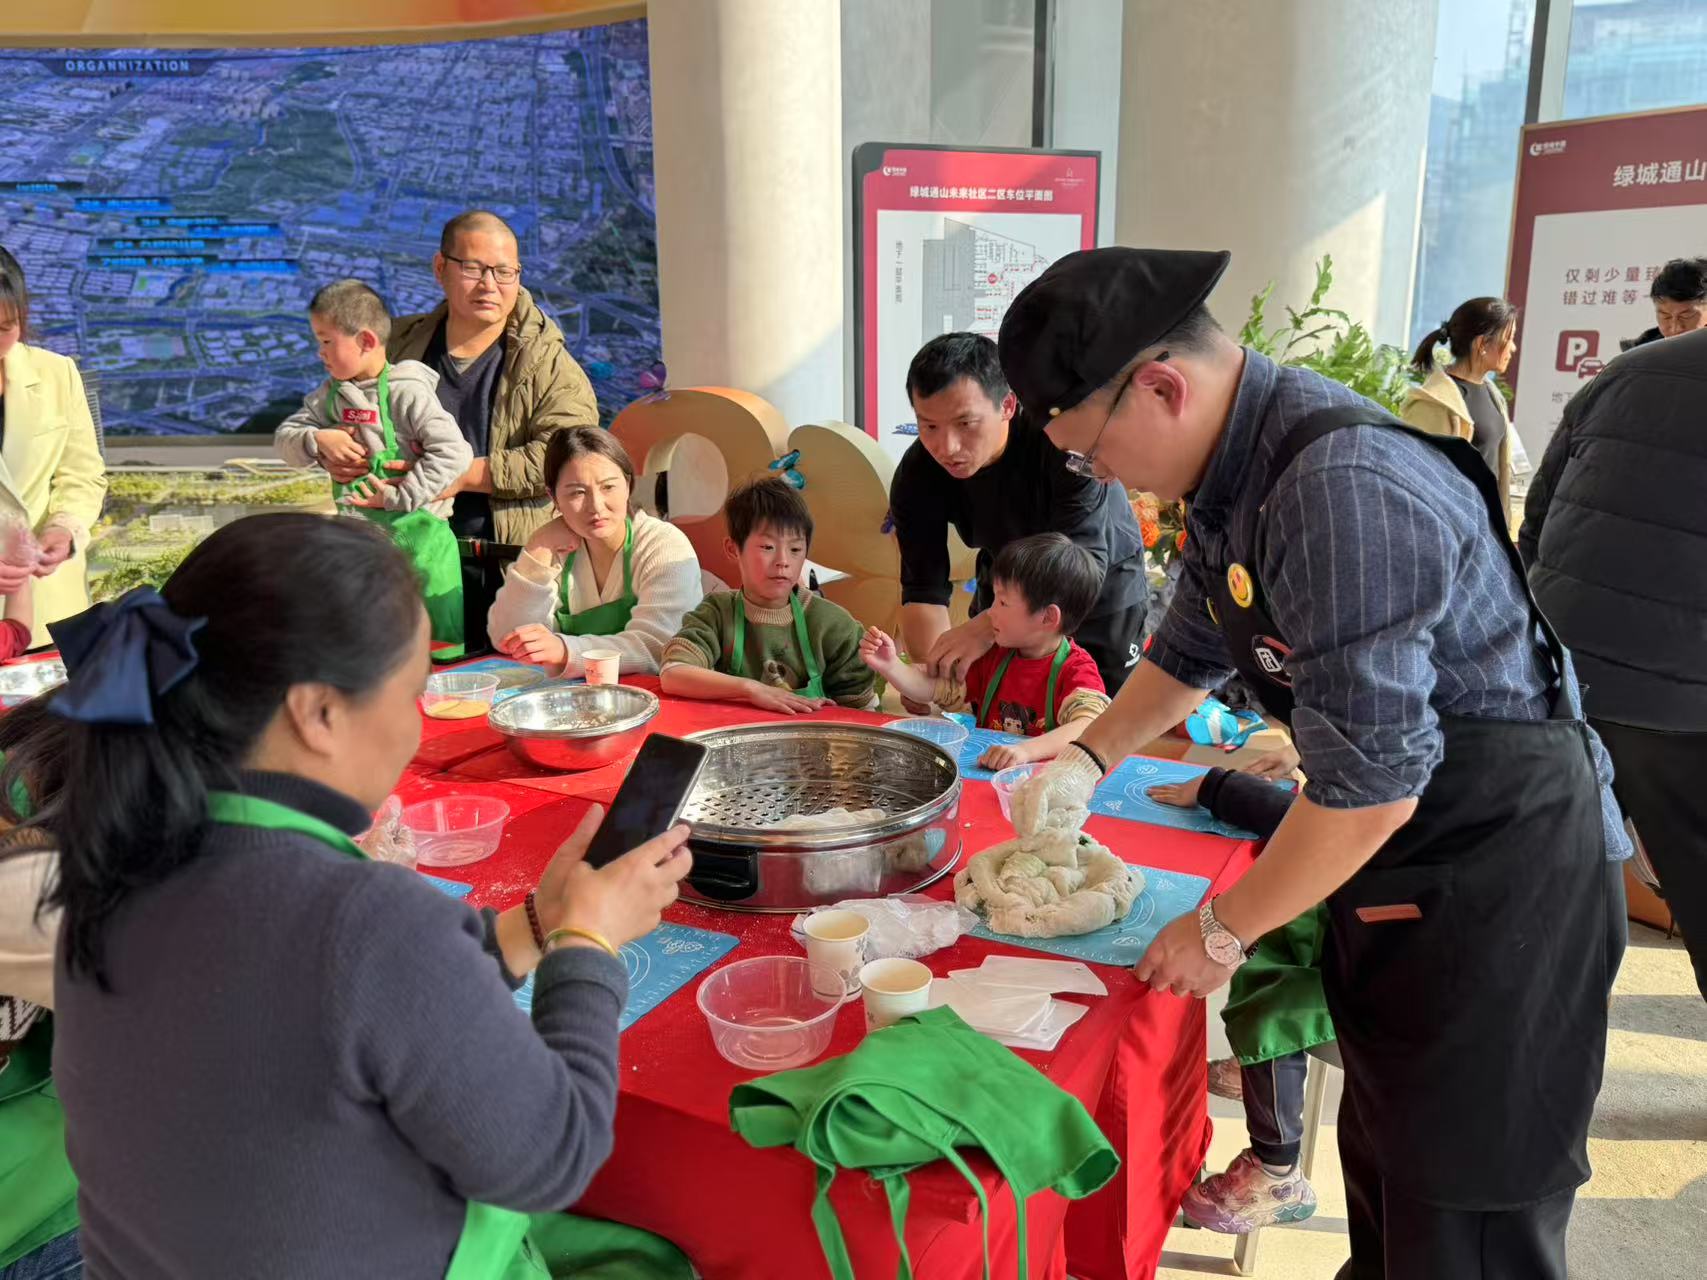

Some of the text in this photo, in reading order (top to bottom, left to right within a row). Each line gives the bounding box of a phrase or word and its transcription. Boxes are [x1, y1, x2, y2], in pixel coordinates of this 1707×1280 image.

[65, 60, 190, 72] ORGANNIZATION
[1613, 158, 1707, 187] 绿城通山
